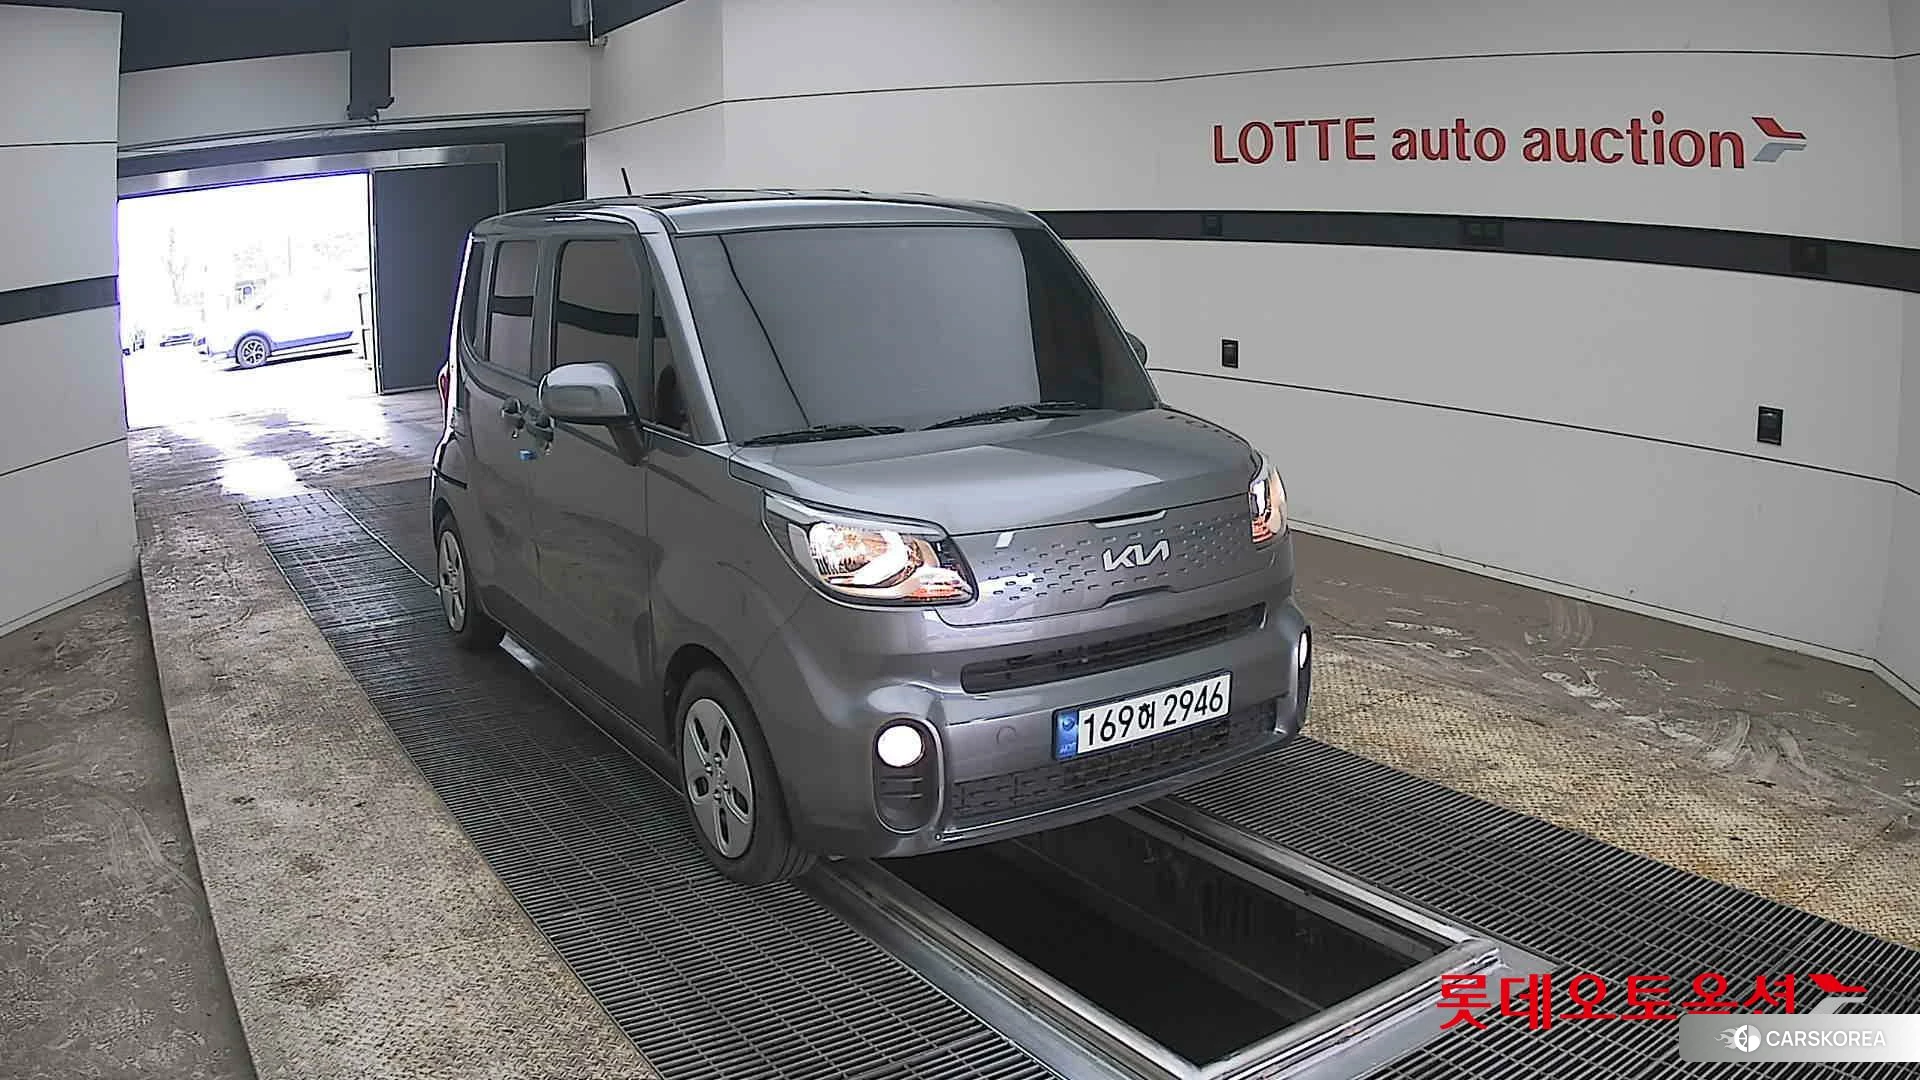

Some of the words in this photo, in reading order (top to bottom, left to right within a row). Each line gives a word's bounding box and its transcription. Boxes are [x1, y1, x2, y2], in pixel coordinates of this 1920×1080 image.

[1212, 116, 1376, 165] LOTTE
[1391, 117, 1507, 163] auto
[1522, 109, 1745, 169] auction
[1101, 538, 1171, 573] KIA
[1083, 701, 1156, 746] 169허
[1163, 681, 1224, 727] 2946
